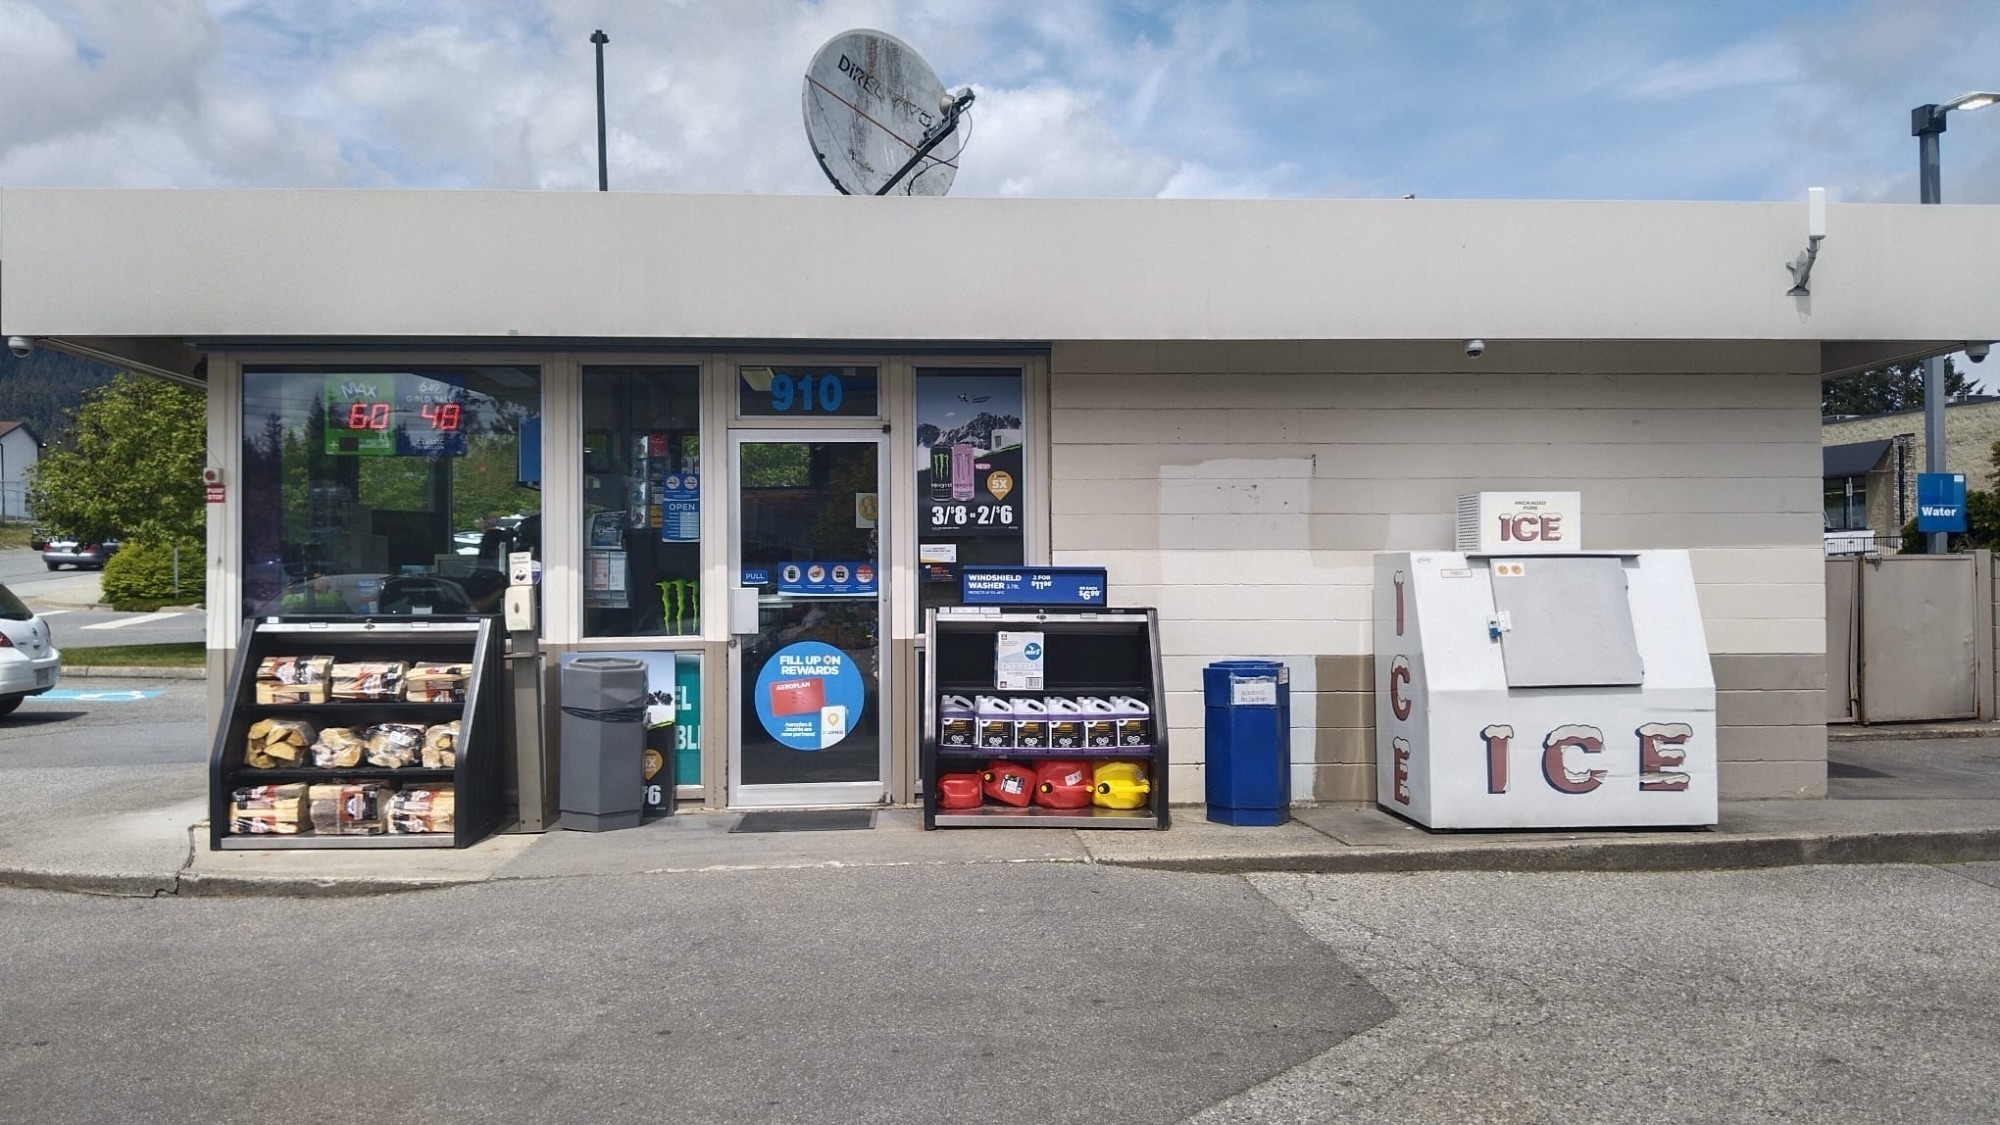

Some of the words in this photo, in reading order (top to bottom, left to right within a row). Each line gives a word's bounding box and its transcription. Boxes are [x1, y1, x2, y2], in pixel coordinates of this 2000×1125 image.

[771, 374, 842, 411] 910
[349, 403, 390, 429] 60
[421, 404, 460, 429] 48
[992, 479, 1007, 488] 5X
[669, 503, 696, 511] OPEN
[1922, 506, 1956, 516] Water
[1498, 512, 1562, 541] ICE
[780, 655, 803, 665] FILL
[805, 655, 821, 665] UP
[823, 655, 841, 665] ON
[781, 666, 839, 675] REWARDS
[776, 681, 810, 691] AEROPLAN
[1390, 570, 1411, 805] ICE
[1480, 722, 1693, 795] ICE
